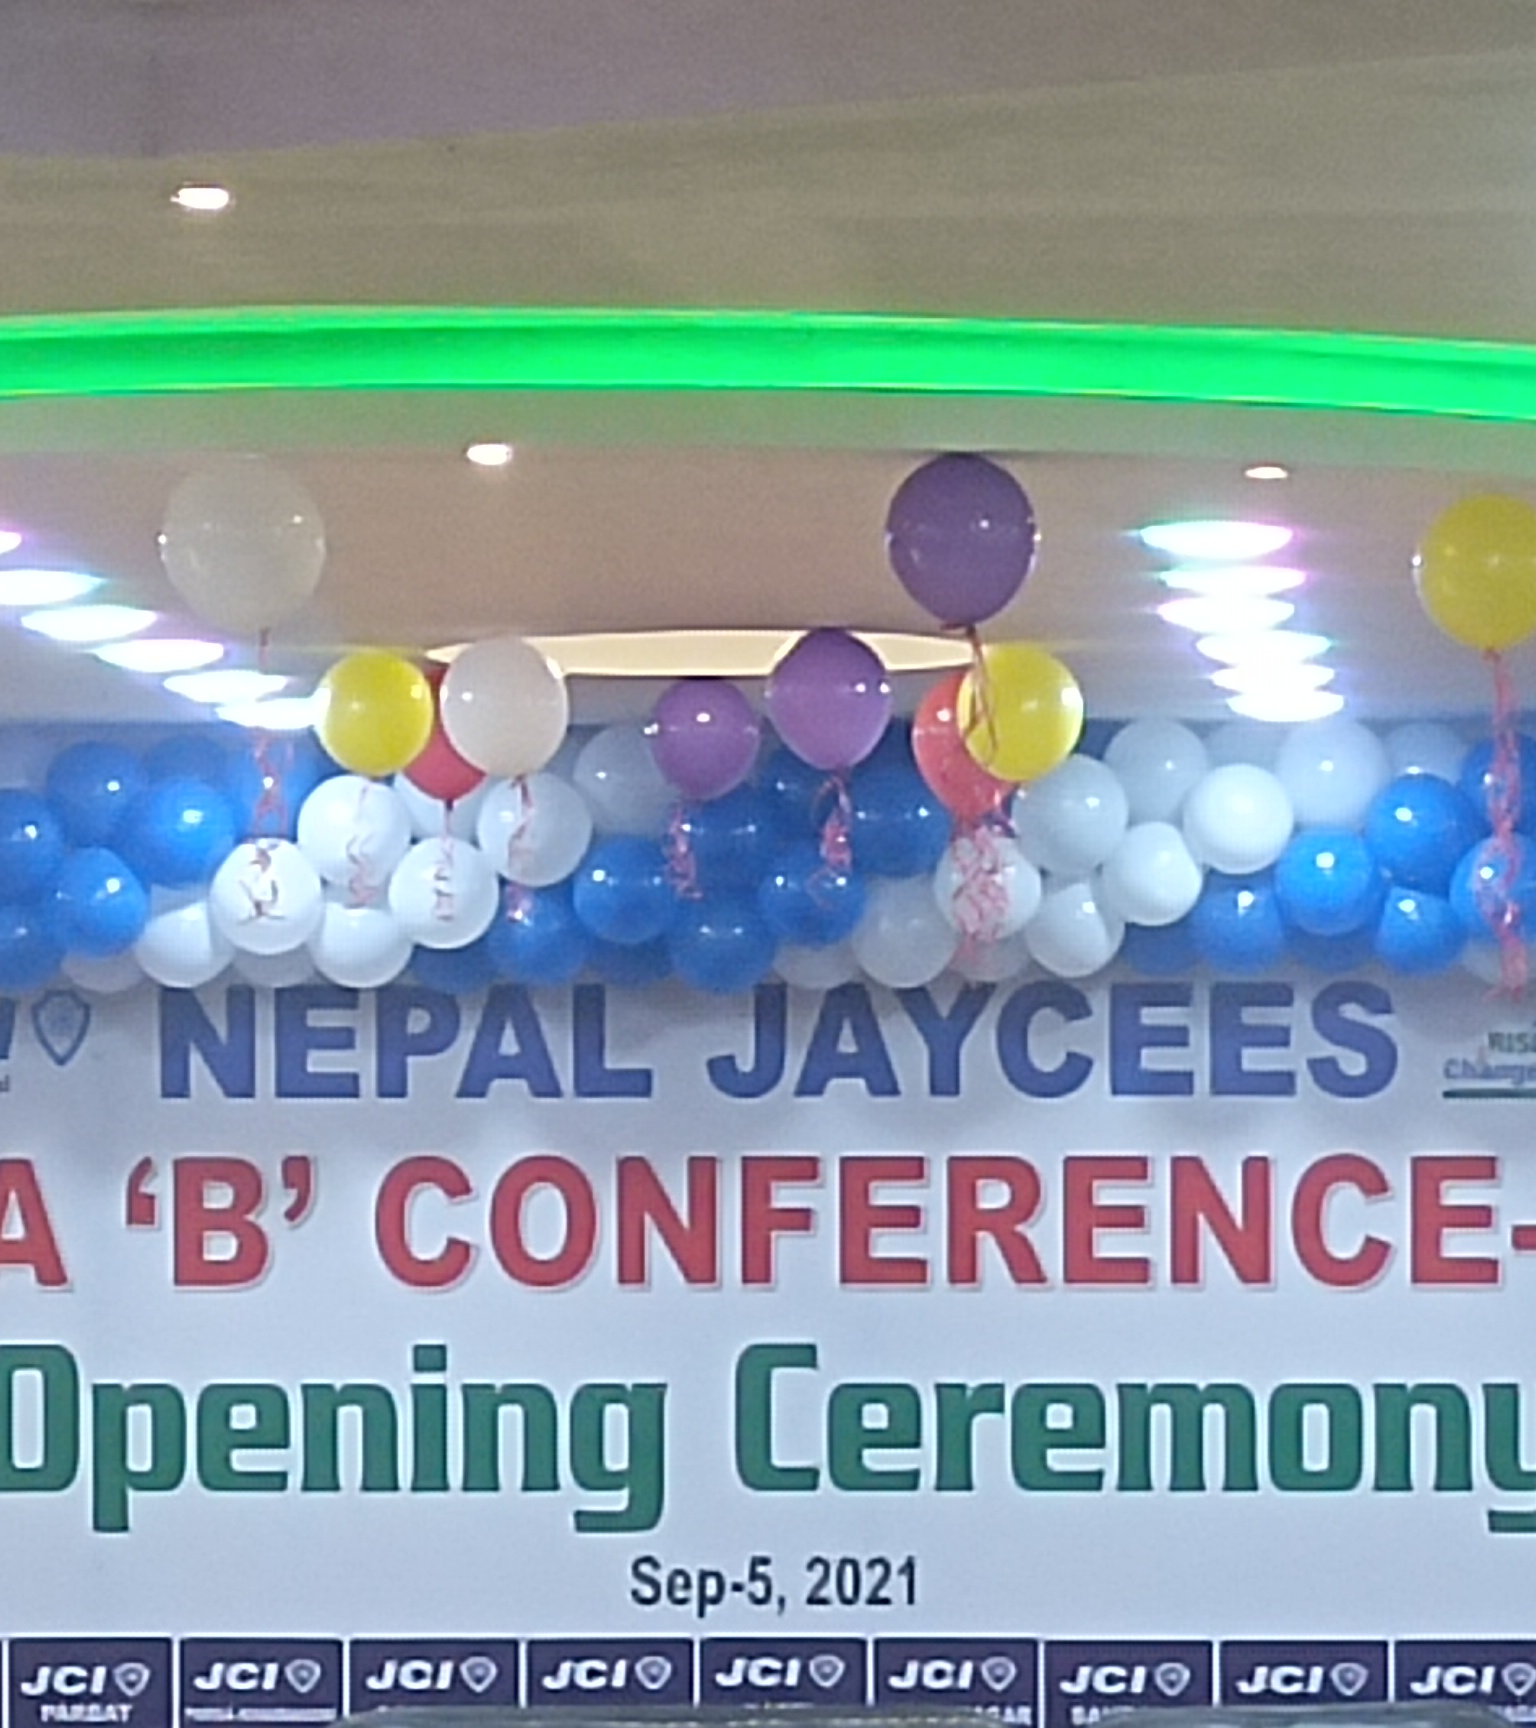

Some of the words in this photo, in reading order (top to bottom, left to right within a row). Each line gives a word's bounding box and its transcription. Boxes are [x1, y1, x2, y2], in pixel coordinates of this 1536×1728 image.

[159, 984, 653, 1099] NEPAL
[706, 980, 1401, 1099] JAYCEES
[629, 1555, 788, 1618] Sep-5,
[805, 1555, 921, 1608] 2021
[20, 1665, 107, 1695] JCI
[193, 1661, 280, 1690] JCI
[366, 1659, 454, 1690] JCI
[542, 1658, 628, 1689] JCI
[714, 1657, 801, 1687] JCI
[888, 1659, 974, 1689] JCI
[1059, 1665, 1147, 1694] JCI
[1237, 1665, 1324, 1694] JCI
[1409, 1665, 1496, 1695] JCI
